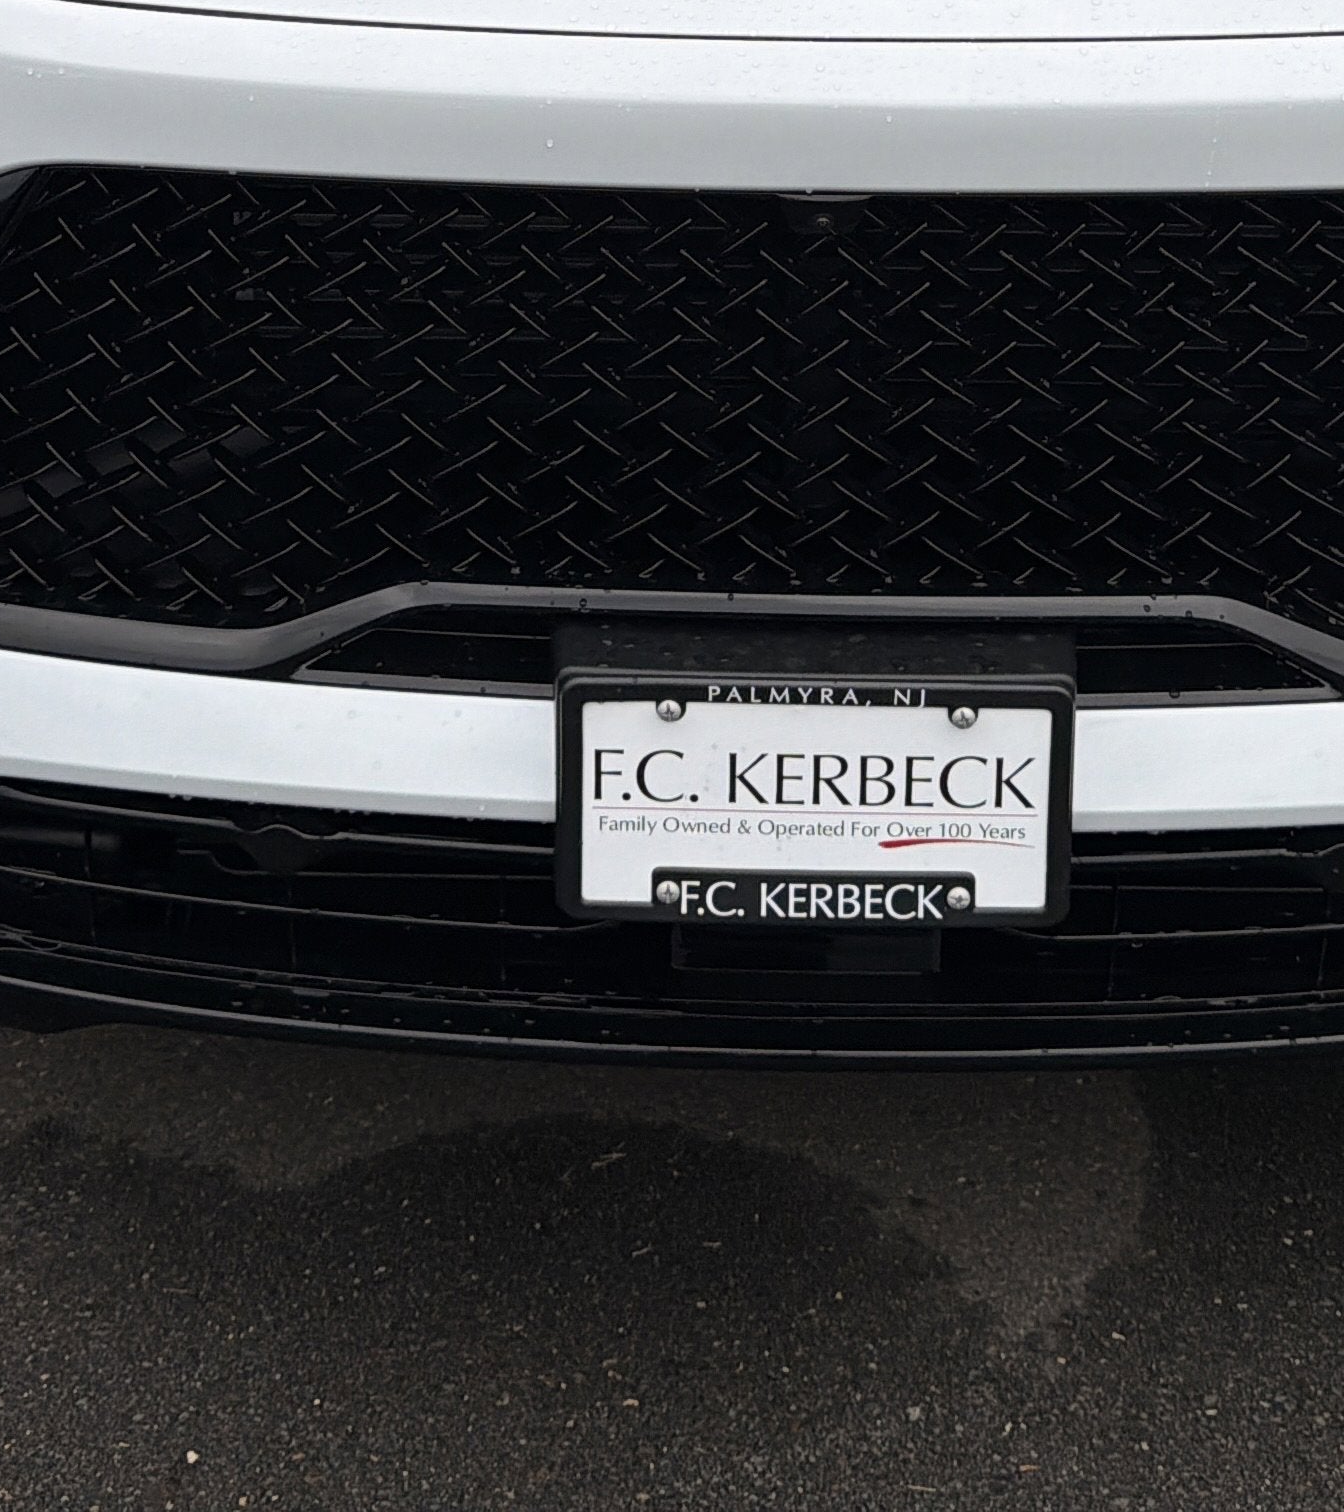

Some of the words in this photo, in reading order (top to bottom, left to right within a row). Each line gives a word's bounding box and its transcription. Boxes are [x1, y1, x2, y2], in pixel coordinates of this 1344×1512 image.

[707, 685, 872, 708] PALMYRA,
[894, 689, 927, 708] NJ
[593, 749, 699, 803] F.C.
[727, 752, 1036, 810] KERBECK
[598, 816, 657, 836] Family
[662, 816, 731, 835] Owned
[737, 819, 751, 835] &
[757, 818, 845, 841] Operated
[850, 821, 880, 838] For
[887, 822, 933, 839] Over
[939, 823, 972, 839] 100
[978, 822, 1026, 841] Years
[679, 880, 745, 917] F.C.
[759, 882, 944, 921] KERBECK
